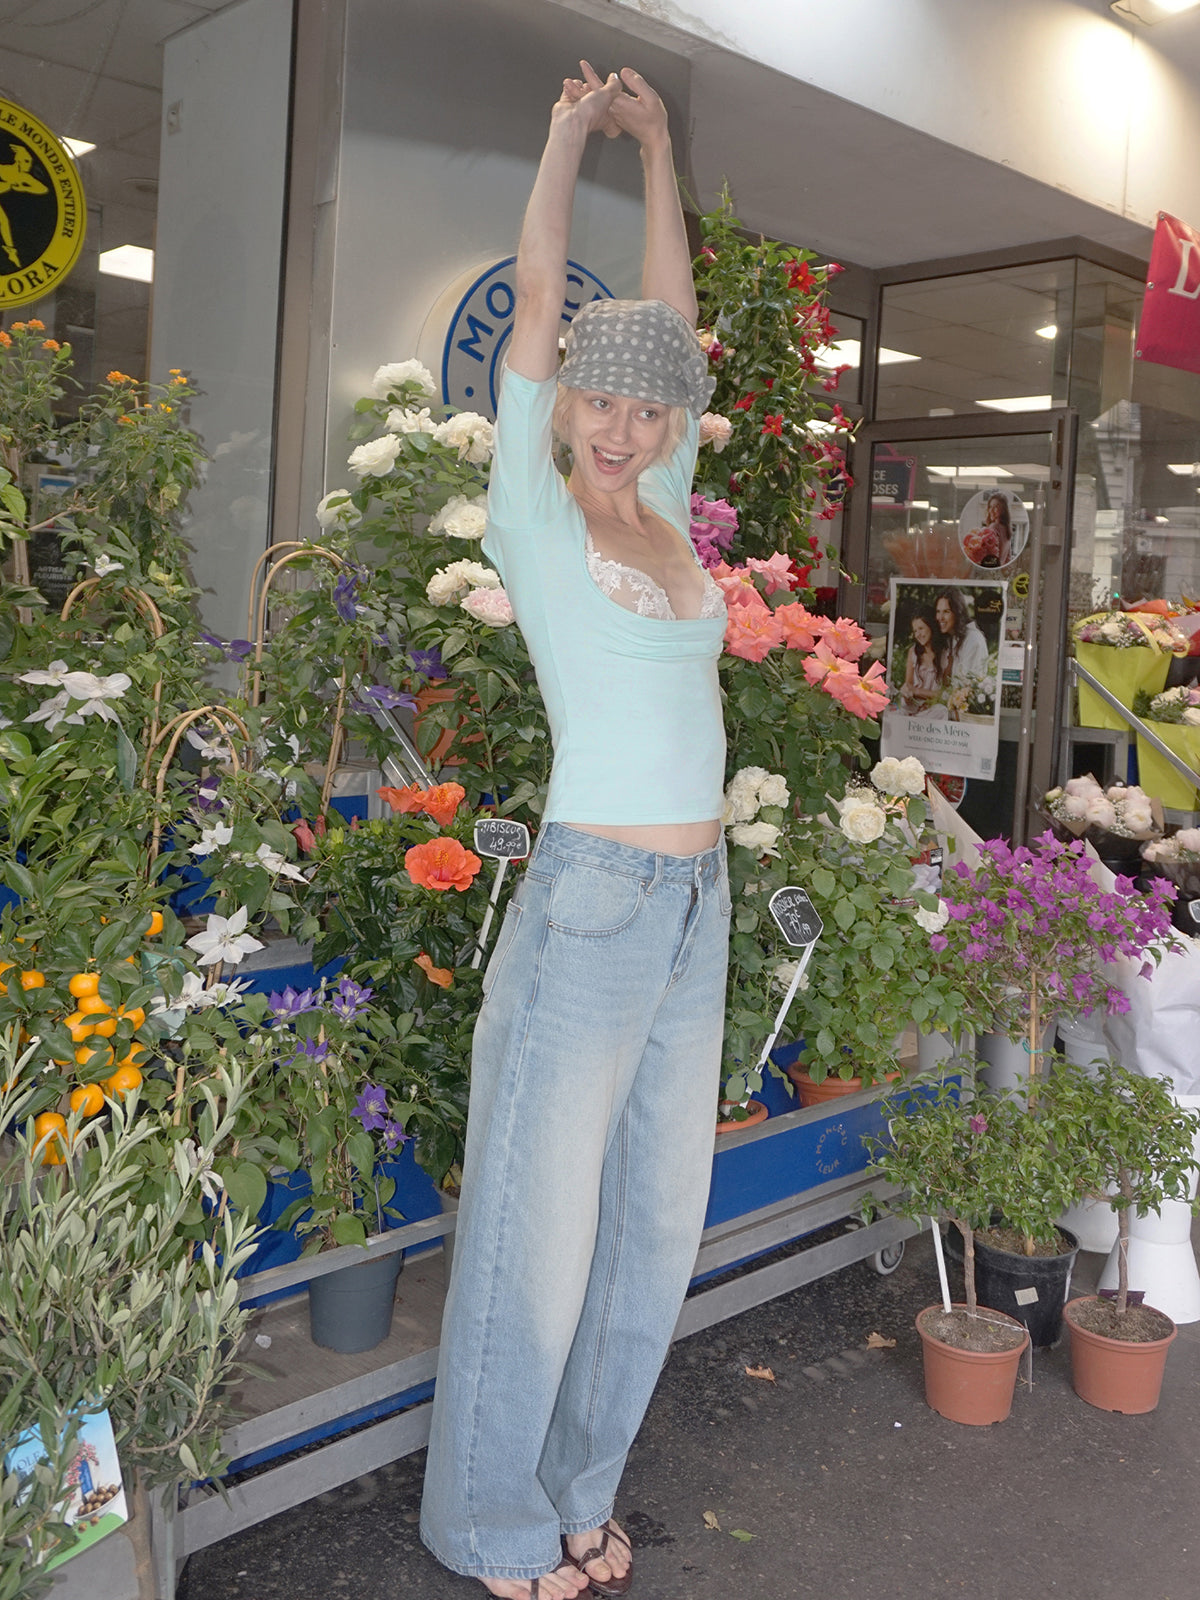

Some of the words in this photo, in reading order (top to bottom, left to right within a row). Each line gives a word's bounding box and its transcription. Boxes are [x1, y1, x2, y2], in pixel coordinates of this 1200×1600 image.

[19, 122, 65, 175] MONDE
[60, 178, 76, 238] ENTIER
[0, 260, 59, 298] ORA
[926, 724, 941, 734] des
